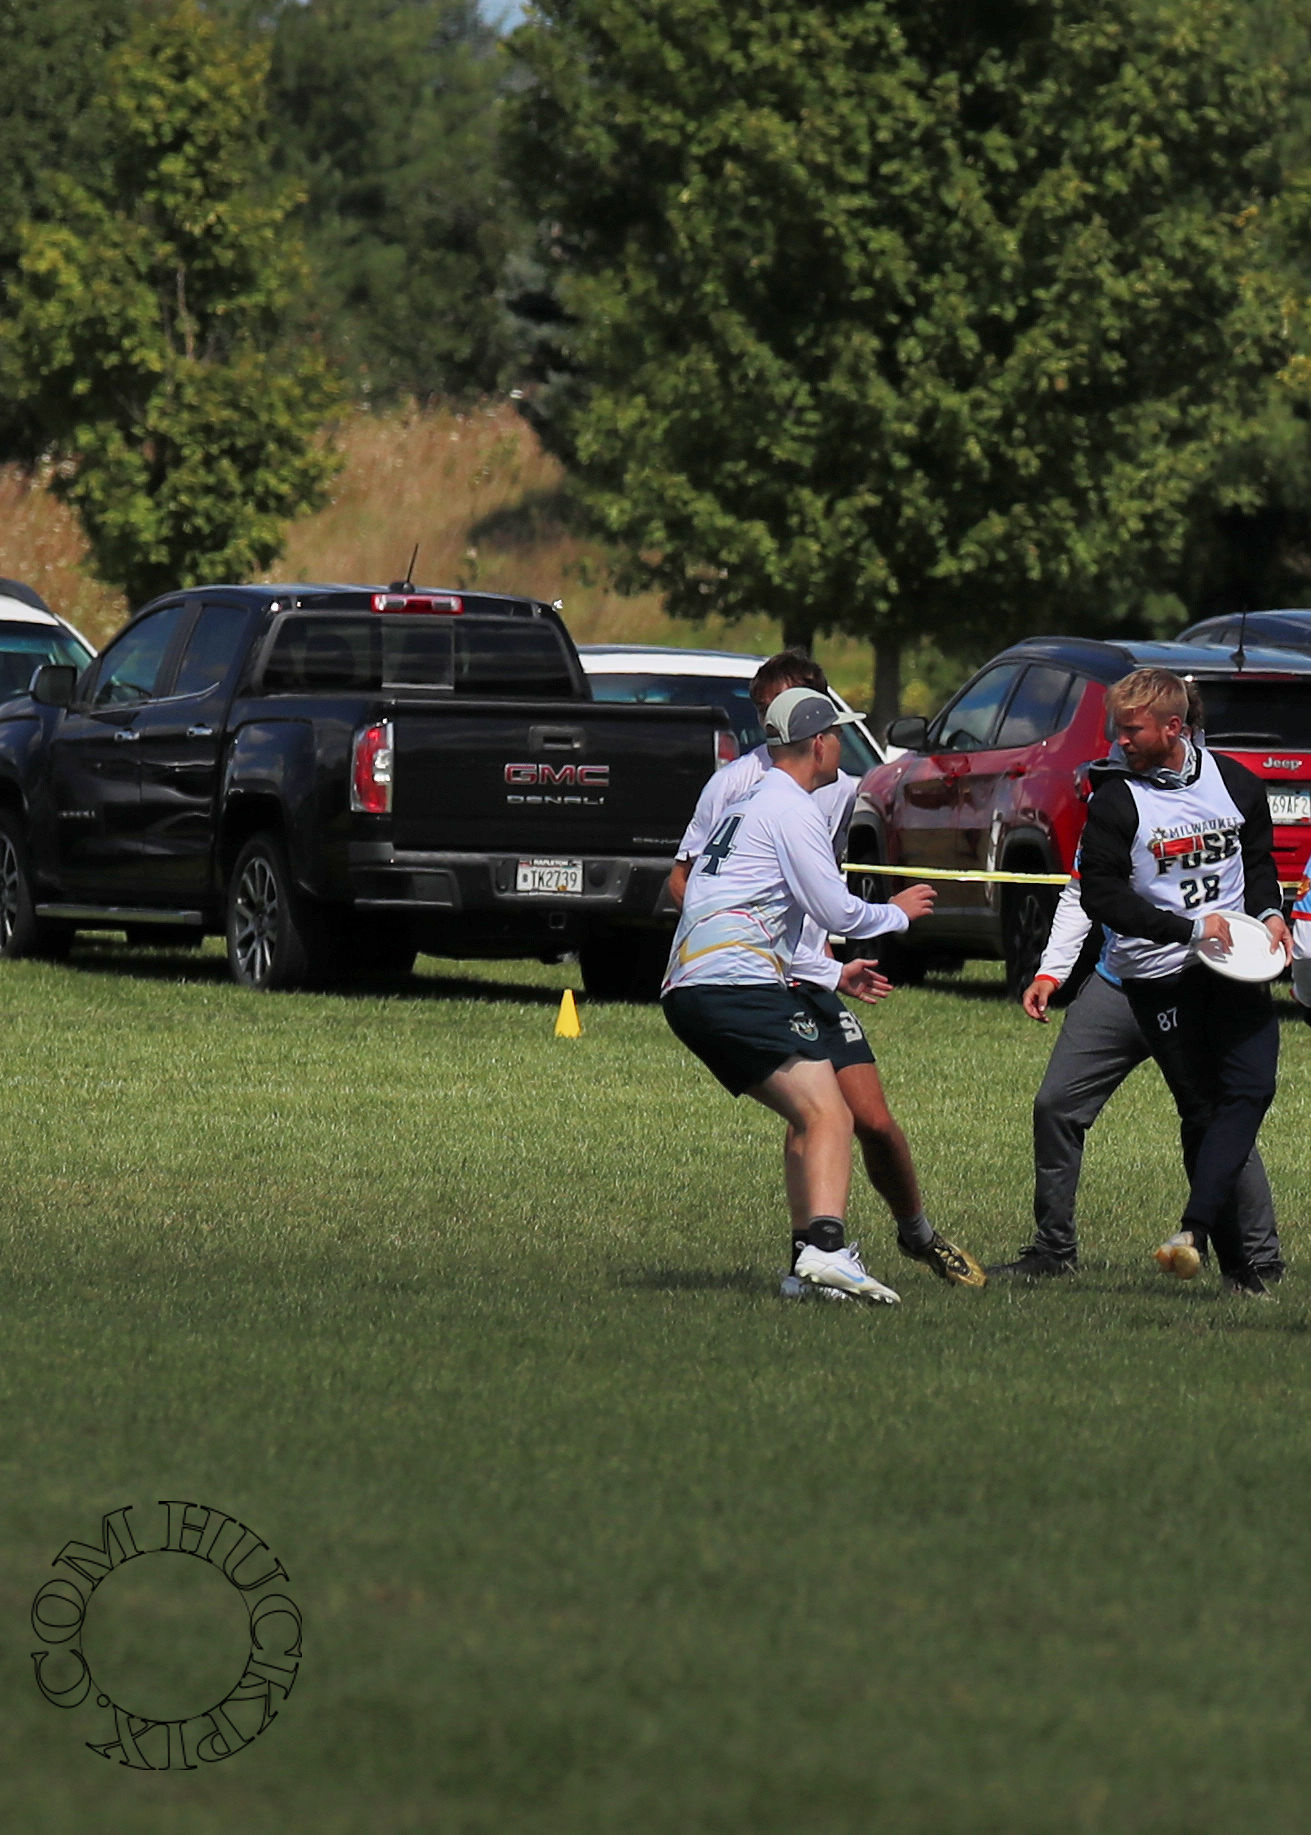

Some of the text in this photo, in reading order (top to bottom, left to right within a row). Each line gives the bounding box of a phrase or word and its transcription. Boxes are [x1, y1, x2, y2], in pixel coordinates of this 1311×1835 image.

[504, 763, 610, 787] GMC
[1262, 757, 1303, 771] Jeep
[507, 795, 604, 805] DENALI
[1266, 794, 1309, 816] 69AF2
[697, 812, 745, 877] 4
[1156, 829, 1240, 876] FUSE
[1179, 874, 1221, 910] 28
[1157, 1006, 1178, 1031] 87
